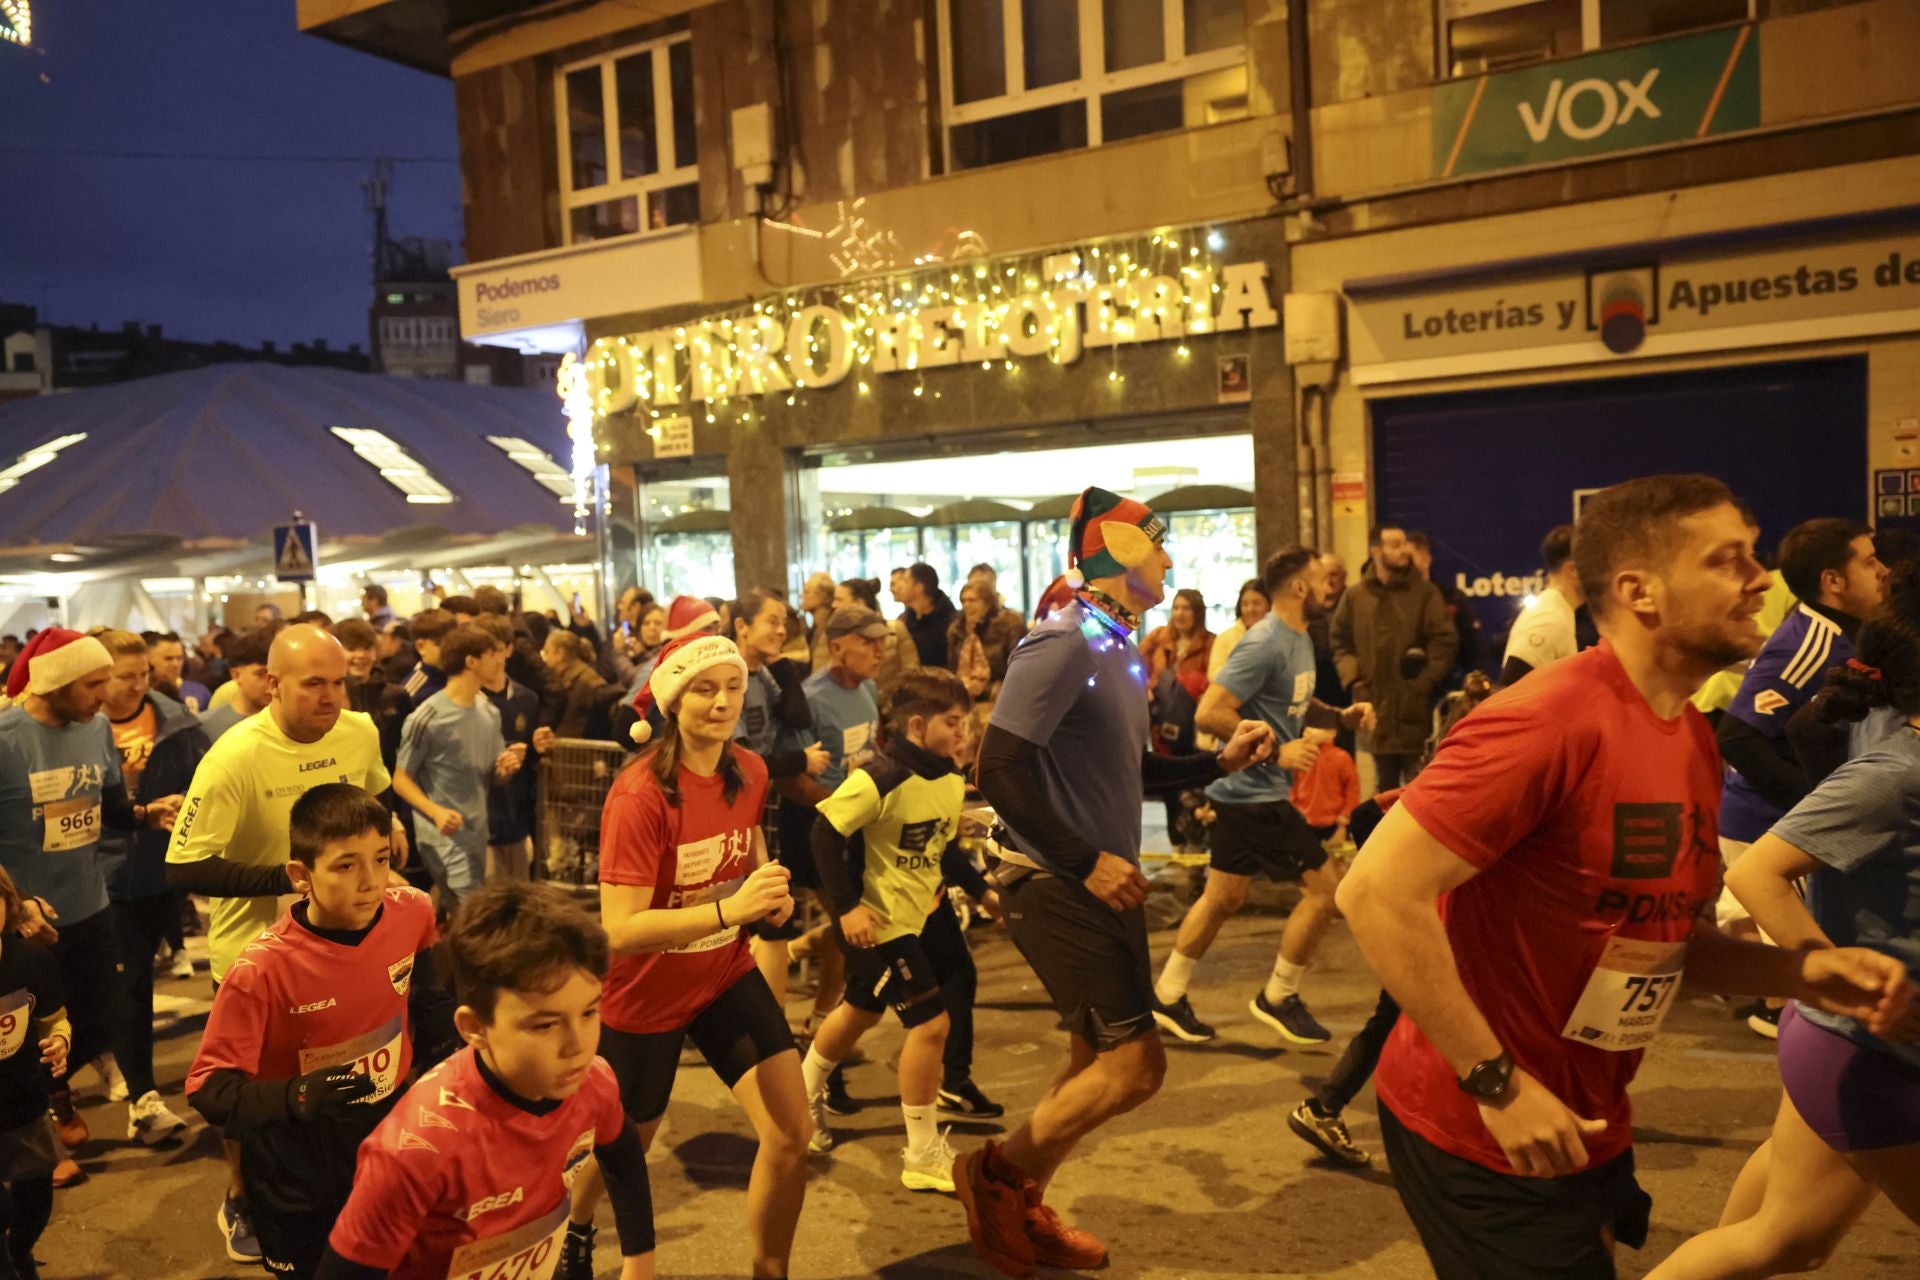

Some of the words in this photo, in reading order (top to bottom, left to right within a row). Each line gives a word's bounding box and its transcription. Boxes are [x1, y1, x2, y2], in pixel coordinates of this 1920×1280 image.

[1518, 68, 1661, 142] VOX
[476, 274, 560, 303] Podemos
[1403, 299, 1544, 340] Loterías
[1557, 300, 1575, 331] y
[1668, 264, 1858, 315] Apuestas
[478, 308, 520, 328] Siero
[584, 304, 853, 414] OTERO
[299, 758, 337, 773] LEGEA
[60, 810, 93, 833] 966
[177, 796, 202, 848] LEGEA
[290, 998, 337, 1014] LEGEA
[1620, 975, 1677, 1012] 757
[348, 1048, 391, 1077] 10
